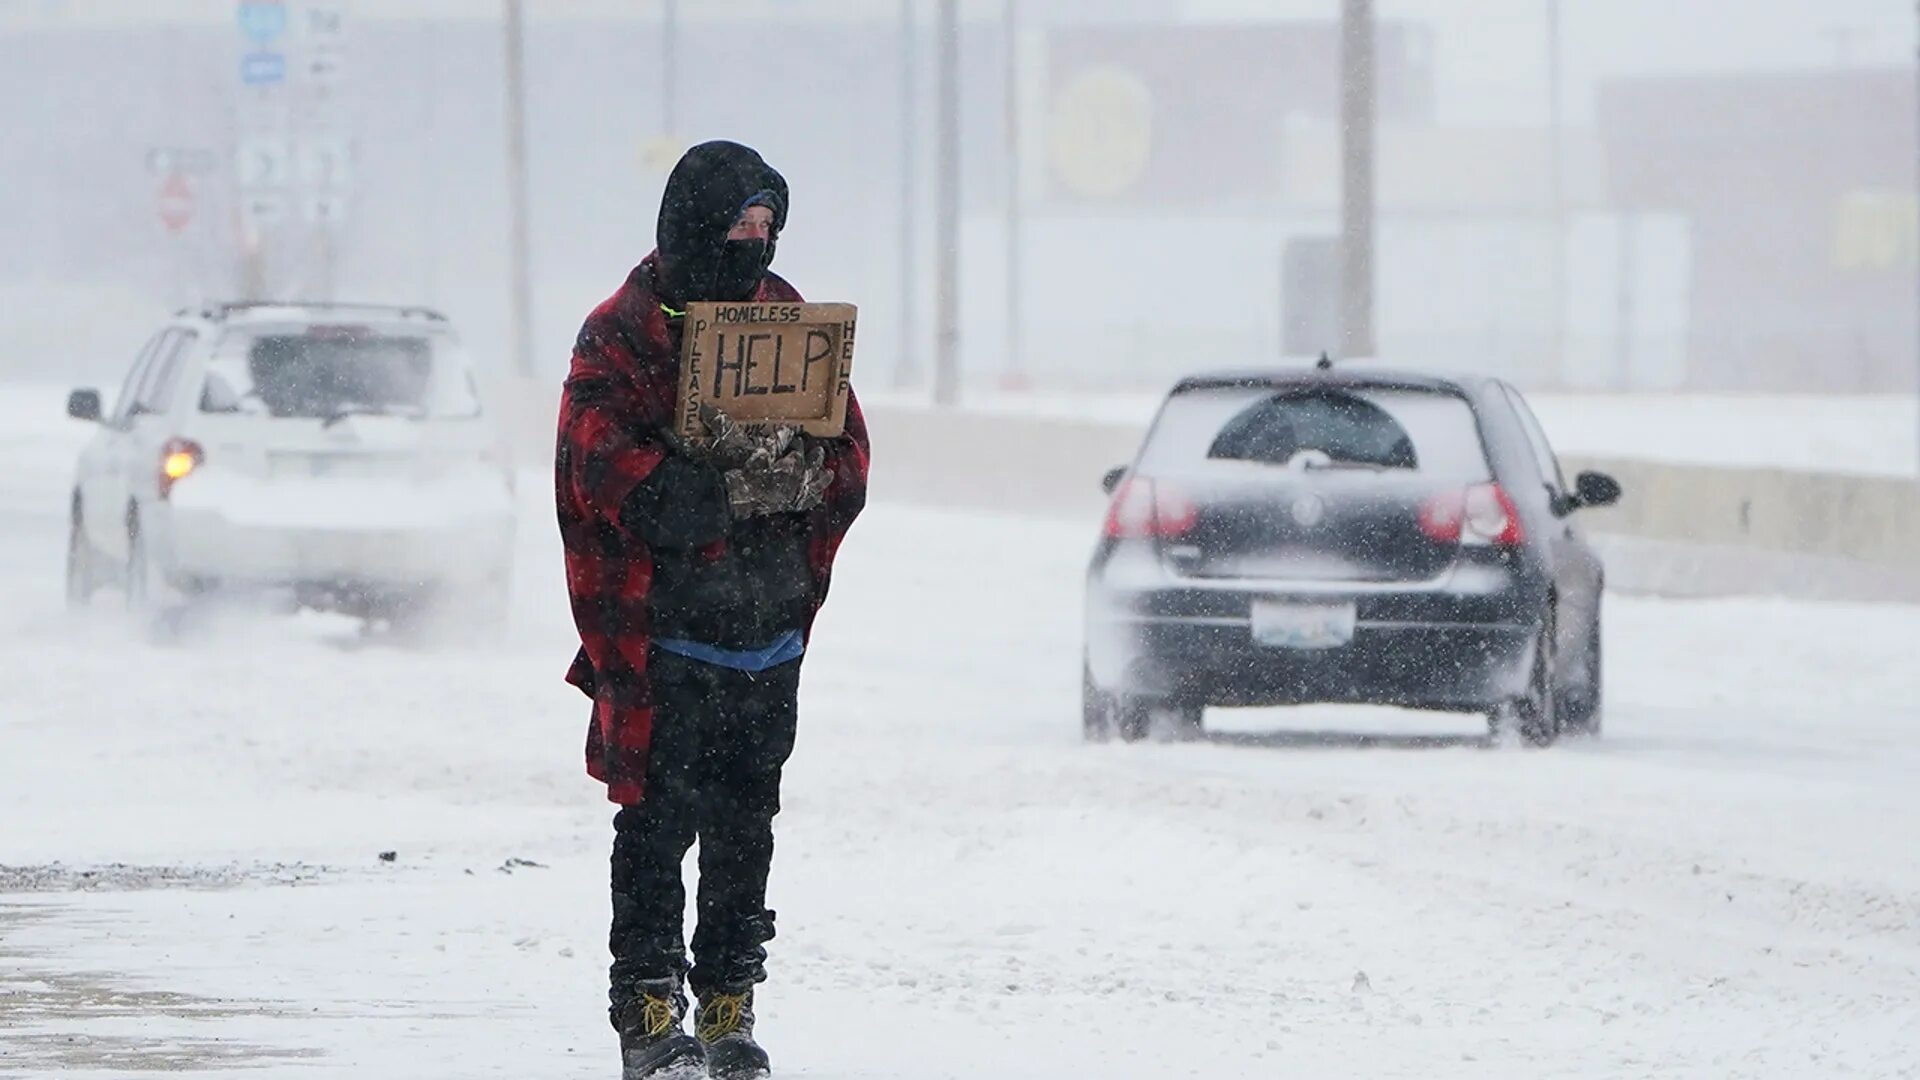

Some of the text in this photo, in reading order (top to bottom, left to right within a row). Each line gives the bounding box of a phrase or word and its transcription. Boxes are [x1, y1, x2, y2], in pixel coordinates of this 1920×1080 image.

[716, 306, 801, 322] HOMELESS
[684, 320, 707, 431] PLEASE
[713, 330, 832, 398] HELP
[837, 320, 855, 396] HELP
